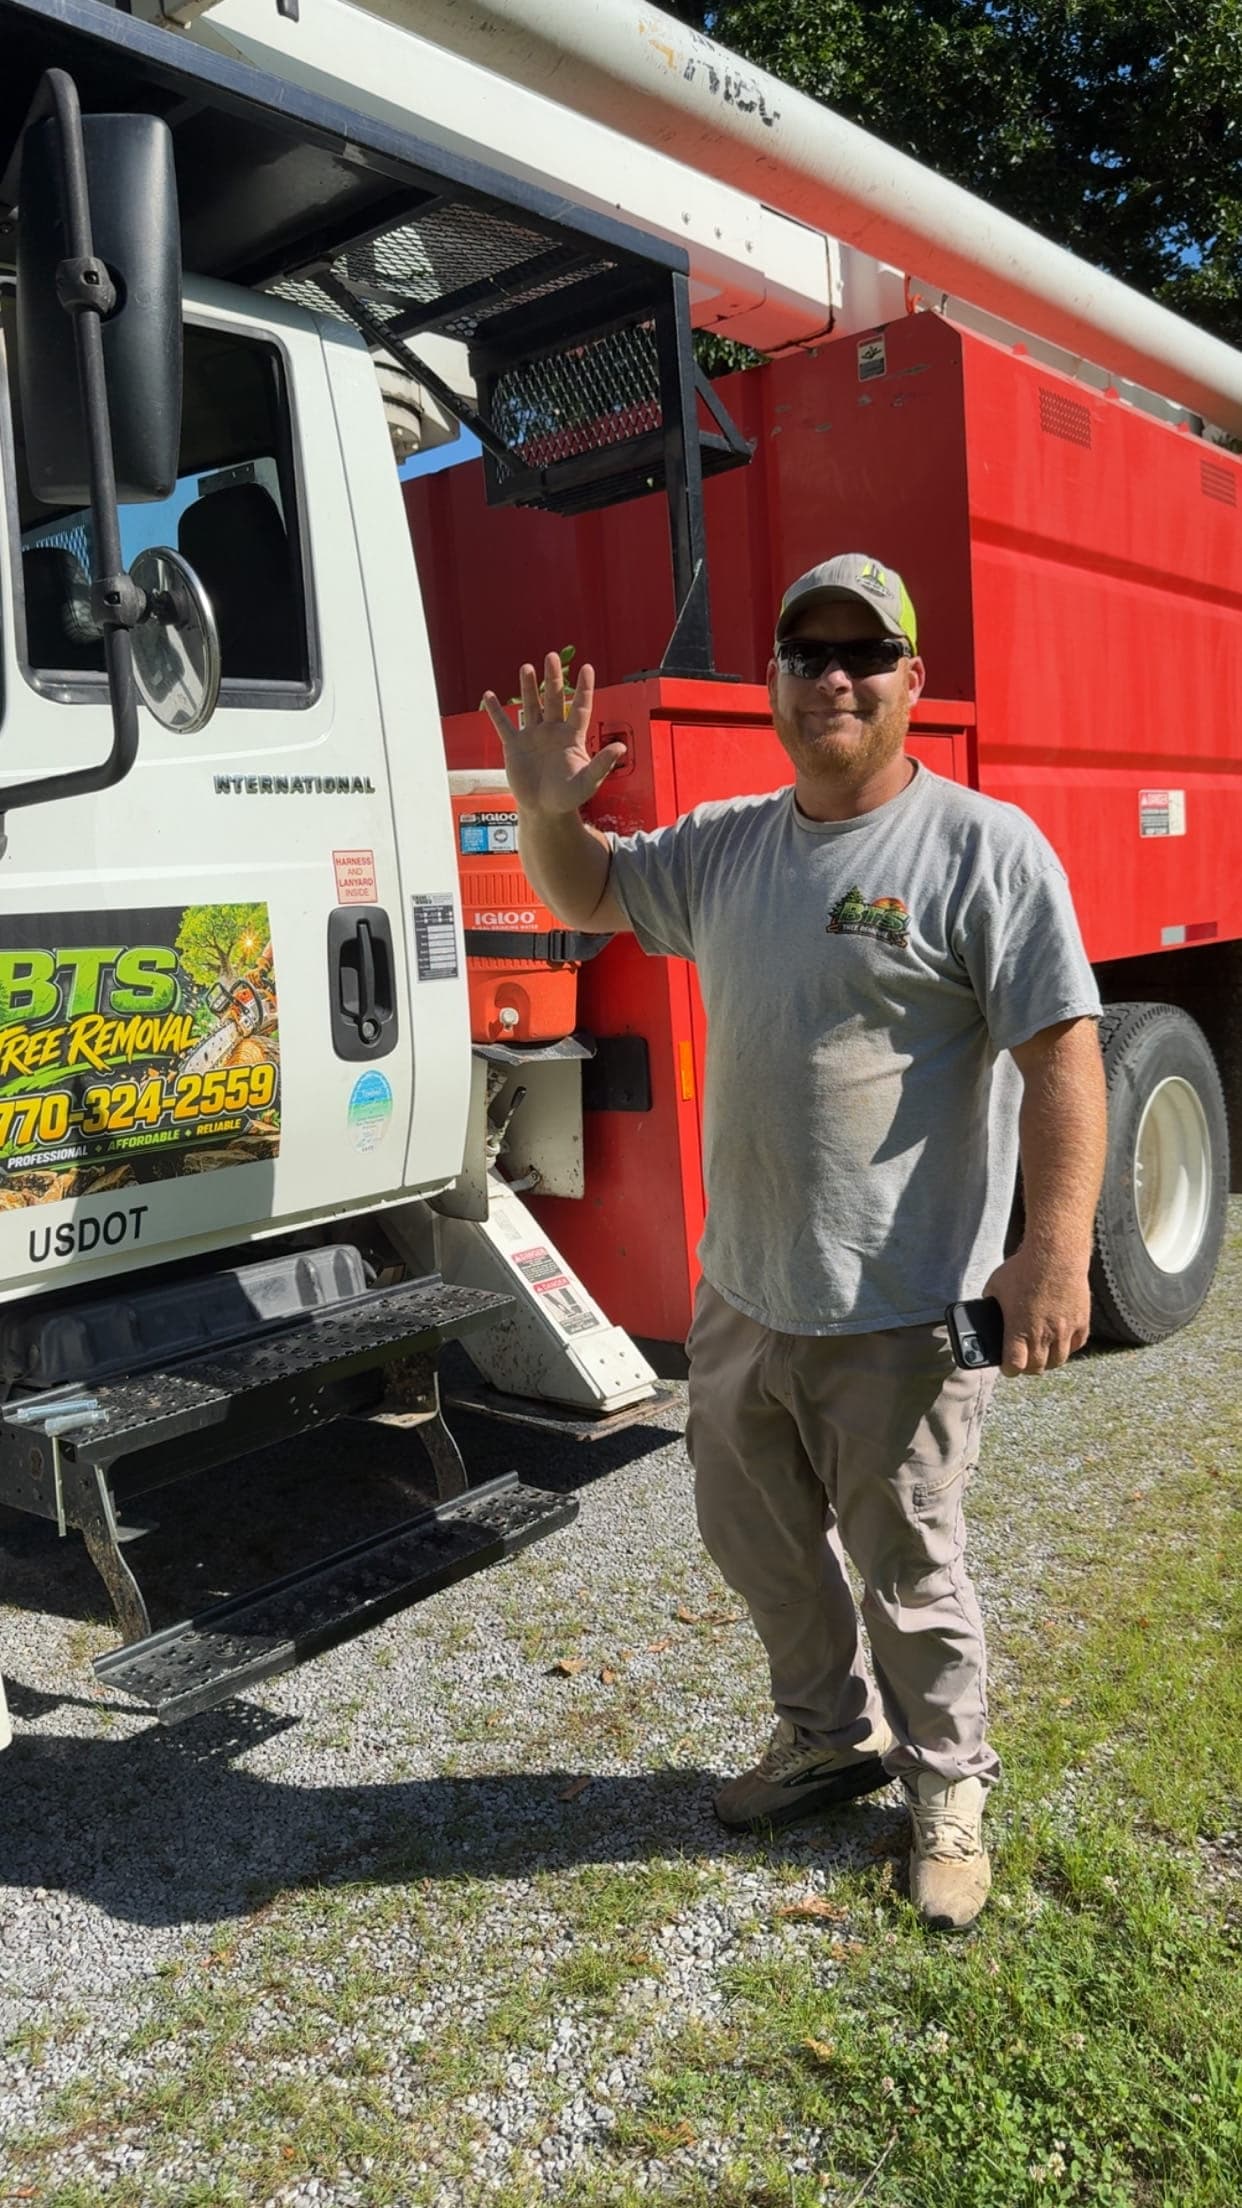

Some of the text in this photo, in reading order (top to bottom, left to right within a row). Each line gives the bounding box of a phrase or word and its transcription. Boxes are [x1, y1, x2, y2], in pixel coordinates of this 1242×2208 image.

[481, 812, 518, 822] IGLOO
[335, 857, 371, 866] HARNESS
[347, 867, 363, 876] AND
[339, 878, 374, 887] LANYARD
[345, 888, 370, 897] INSIDE
[474, 911, 535, 926] IGLOO
[839, 902, 909, 931] BTS
[0, 947, 178, 1020] BTS
[67, 1012, 200, 1072] REMOVAL
[7, 1118, 242, 1169] PROFESSIONAL AFFORDABLE RELIABLE
[29, 1205, 149, 1263] USDOT
[543, 1278, 569, 1290] DANGER
